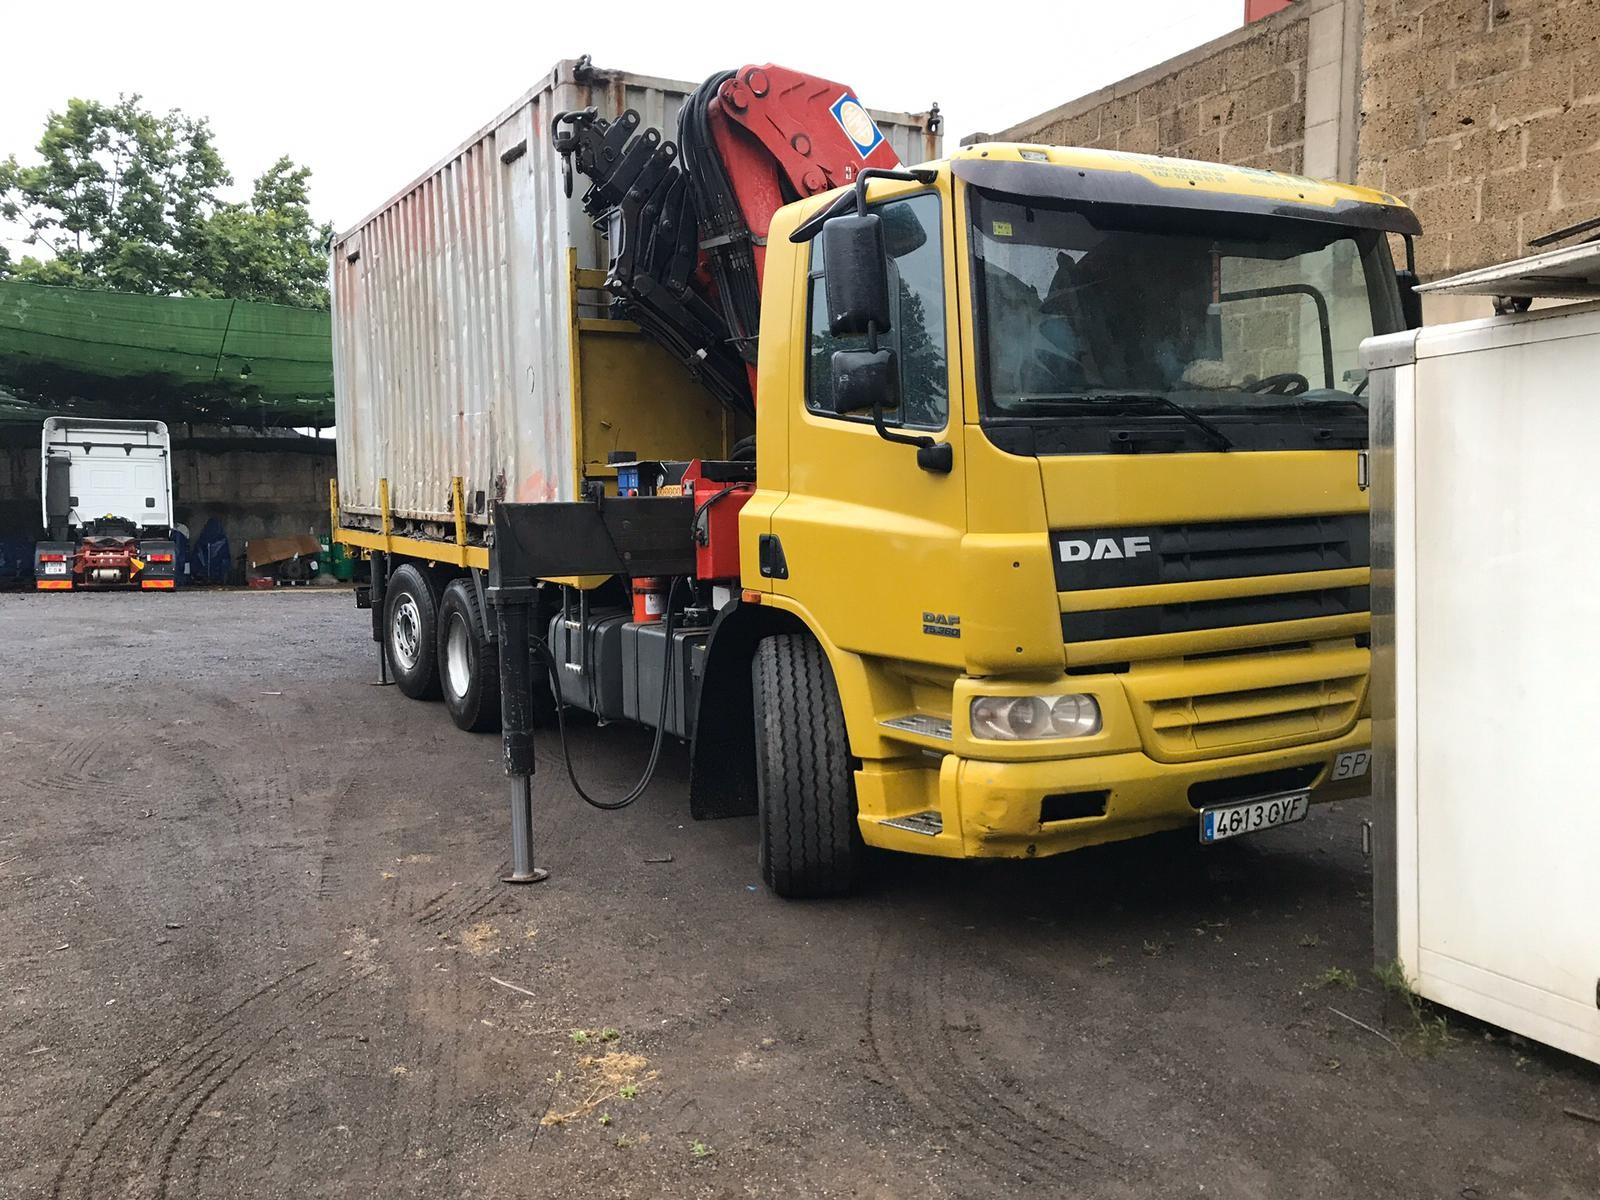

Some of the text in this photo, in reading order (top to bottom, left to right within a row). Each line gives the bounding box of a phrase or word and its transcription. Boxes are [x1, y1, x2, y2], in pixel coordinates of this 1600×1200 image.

[1058, 535, 1151, 562] DAF
[922, 611, 961, 626] DAF
[1338, 753, 1367, 776] SP
[1216, 805, 1264, 836] 4613
